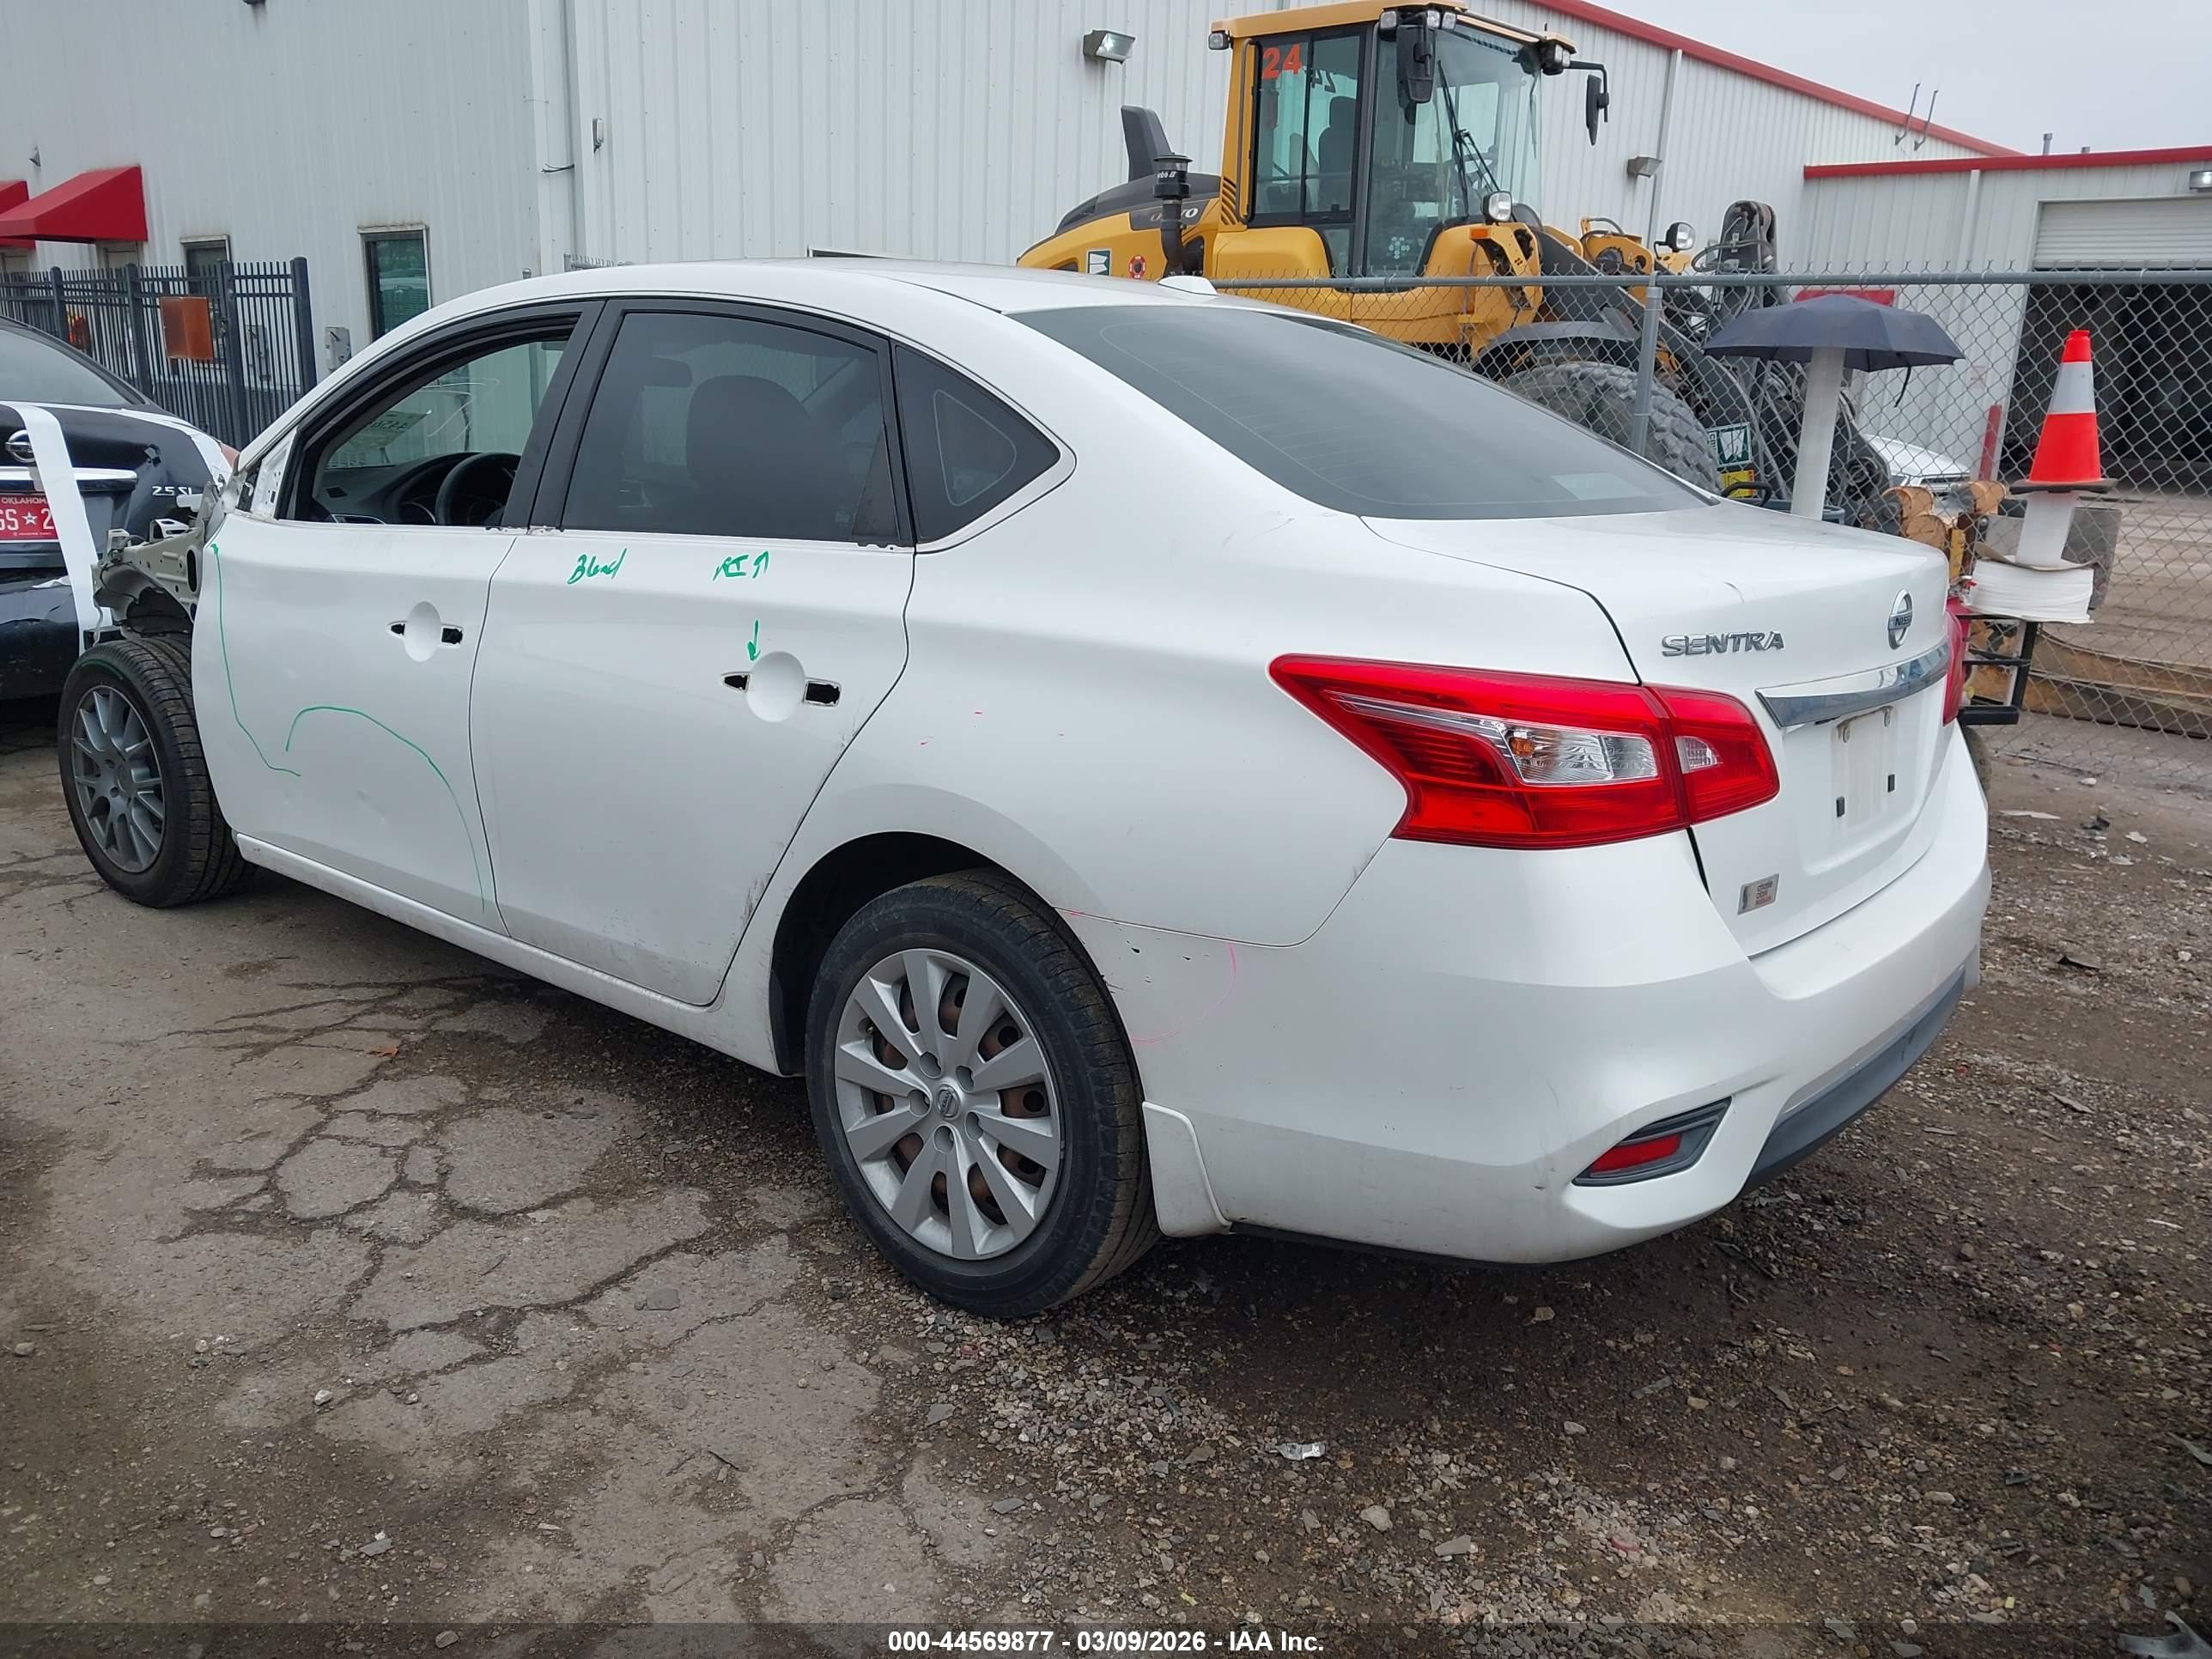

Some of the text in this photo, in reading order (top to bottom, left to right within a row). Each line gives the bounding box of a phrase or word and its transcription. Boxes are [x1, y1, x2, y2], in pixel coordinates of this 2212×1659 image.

[1261, 44, 1303, 80] 24
[1, 496, 47, 505] OKLAHOM
[1662, 630, 1784, 657] SENTRA
